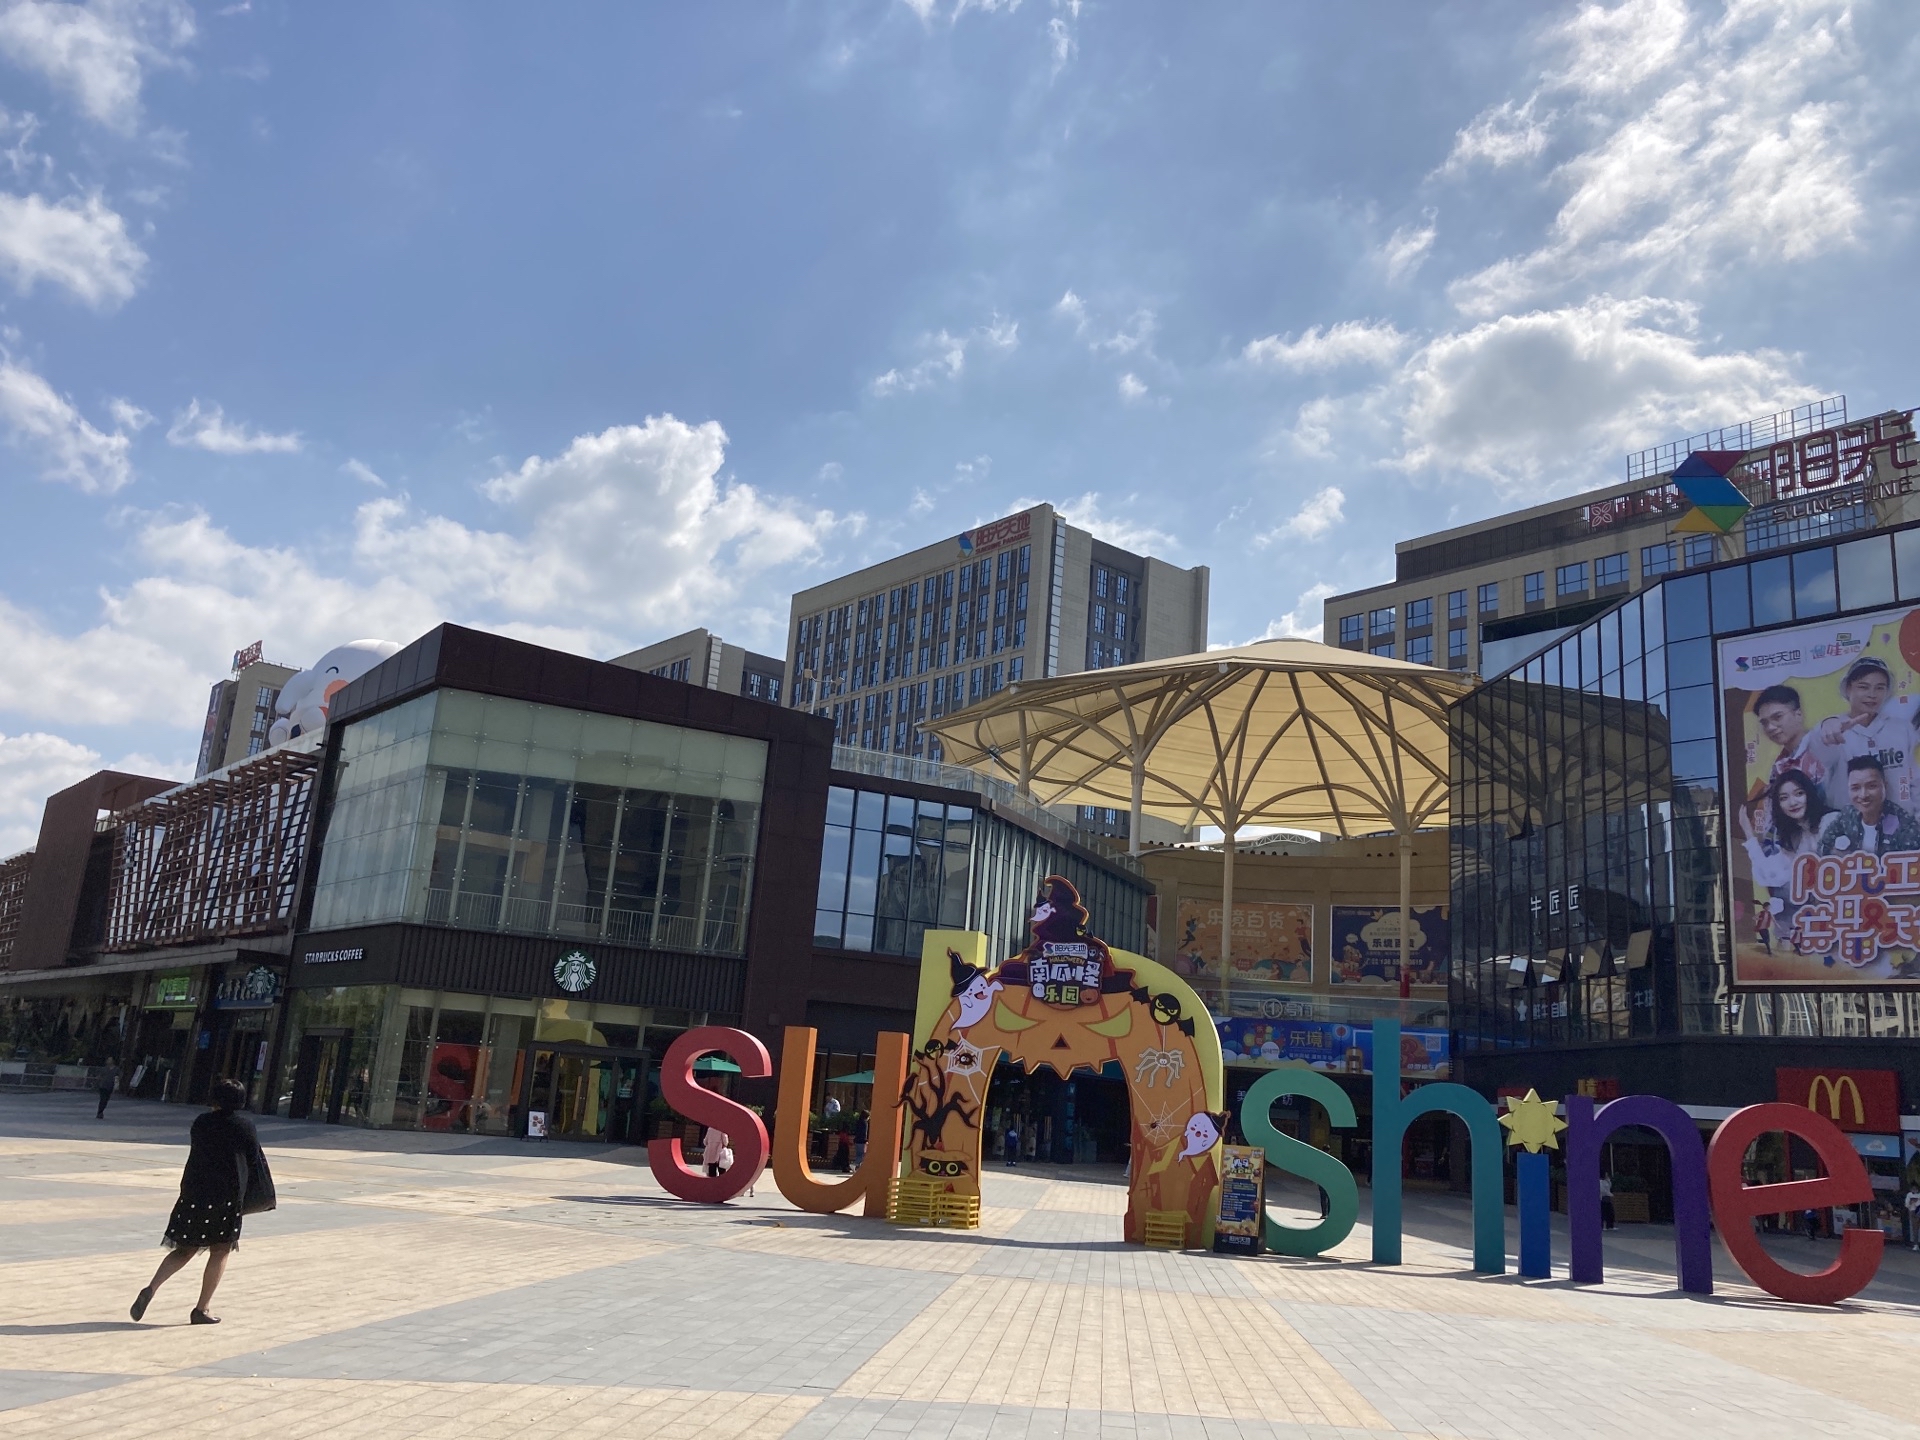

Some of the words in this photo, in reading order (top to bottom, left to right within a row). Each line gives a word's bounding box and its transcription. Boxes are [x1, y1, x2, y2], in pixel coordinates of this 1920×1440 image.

[1770, 411, 1918, 499] 阳光
[1772, 476, 1914, 524] SUNSHINE
[1751, 650, 1801, 667] 阳光天地
[1530, 884, 1579, 919] 牛匠匠
[1798, 895, 1920, 962] 共聚天
[304, 951, 339, 964] STARBUCKS
[339, 948, 364, 961] COFFEE
[1050, 955, 1085, 966] HALLOWEEN
[1029, 958, 1101, 988] 南瓜怪
[1043, 984, 1080, 1005] 乐园
